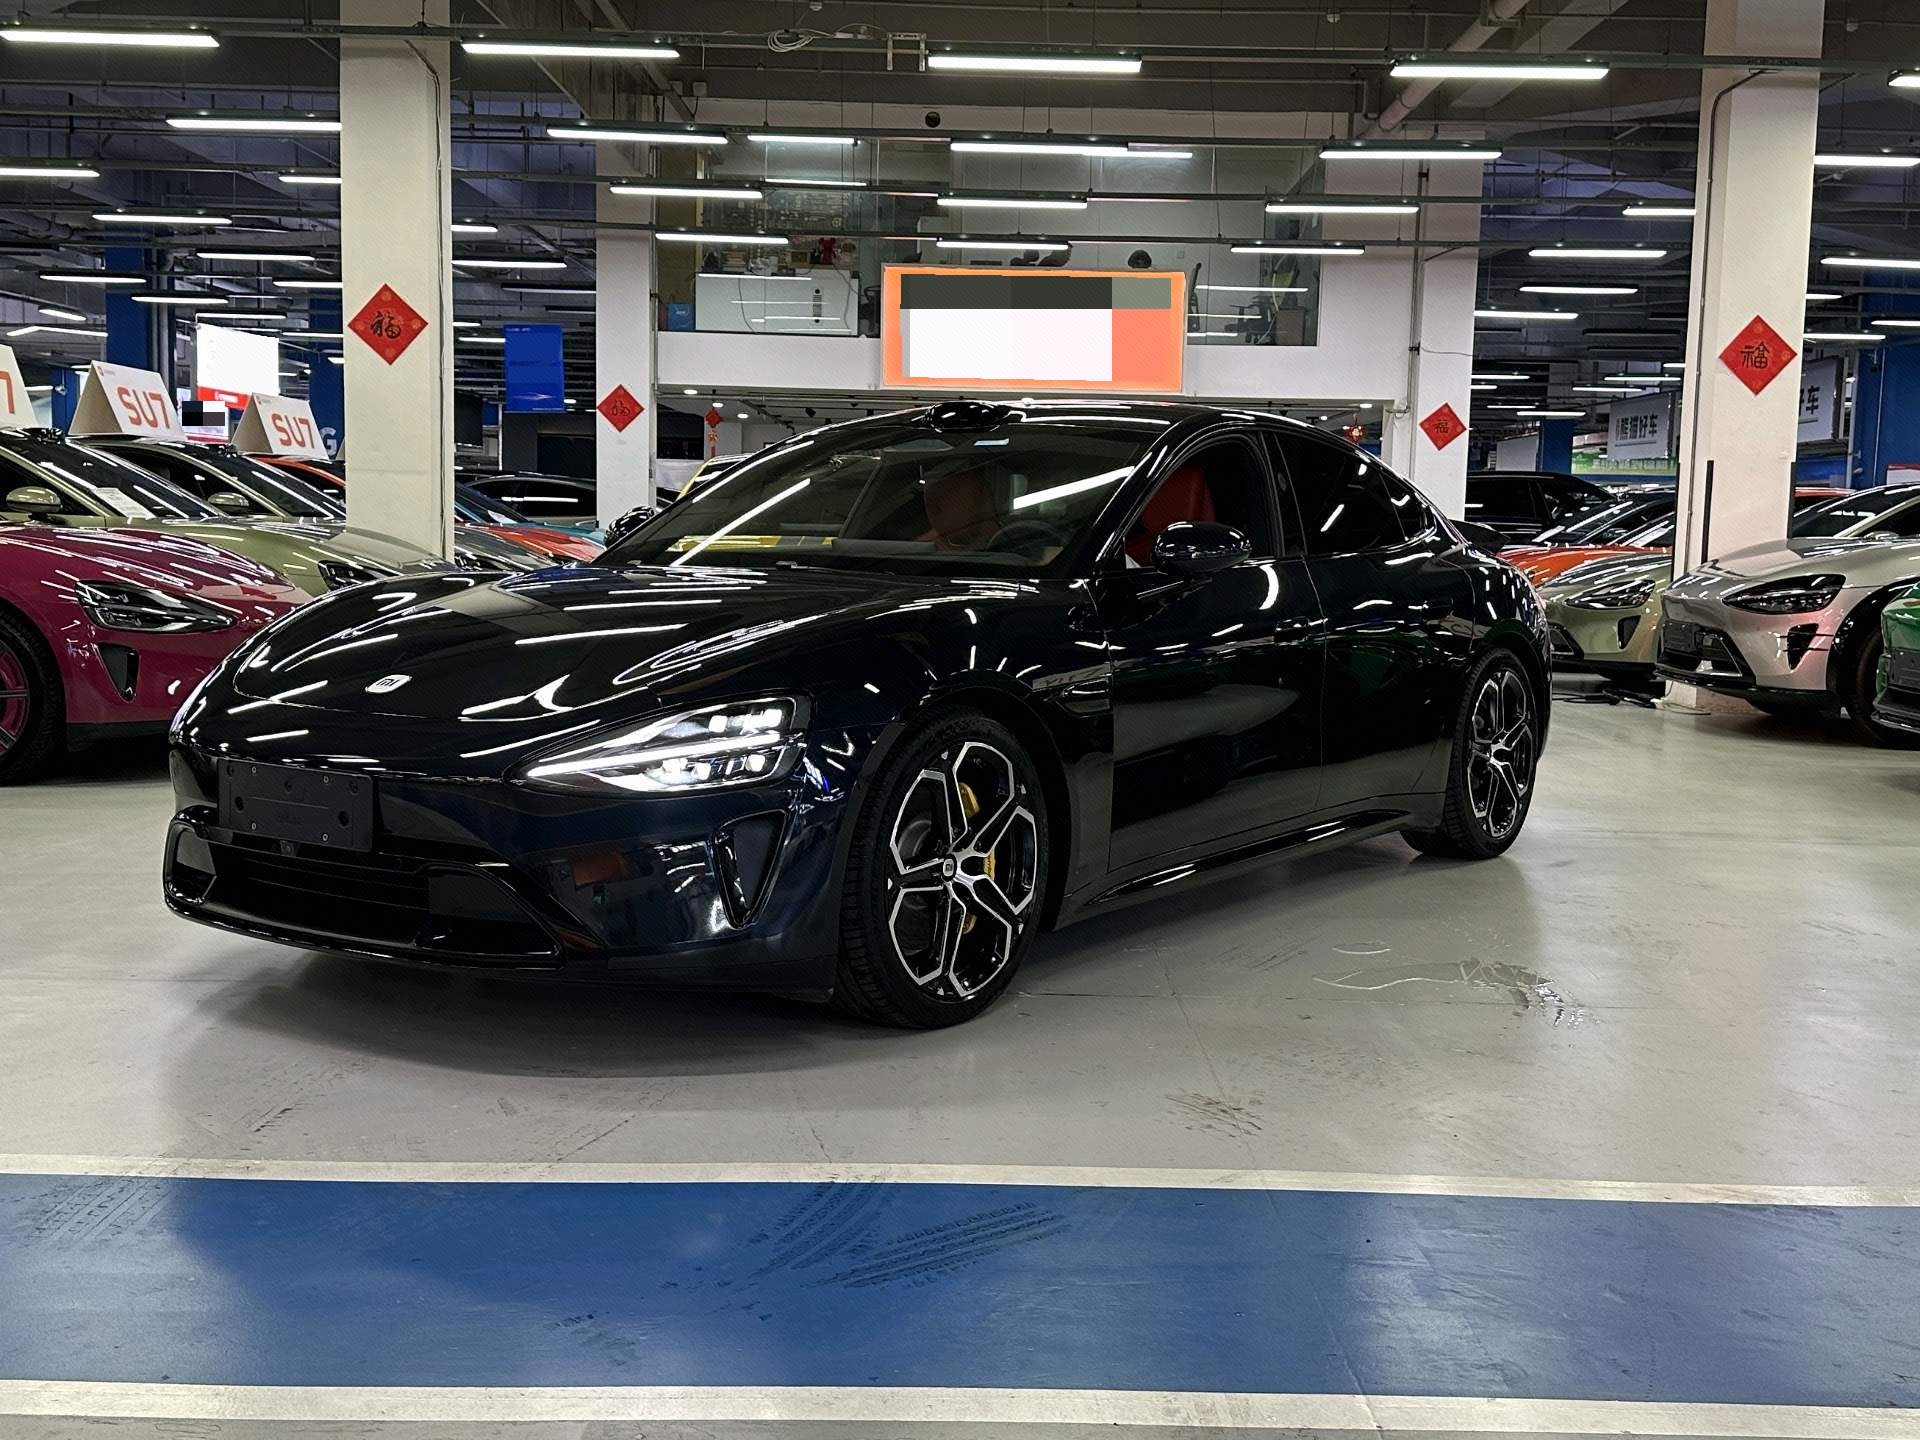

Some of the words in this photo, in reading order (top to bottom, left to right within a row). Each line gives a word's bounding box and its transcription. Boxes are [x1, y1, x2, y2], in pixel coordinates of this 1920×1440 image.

[1739, 341, 1771, 370] 福
[117, 385, 170, 430] SU7
[271, 412, 315, 449] SU7
